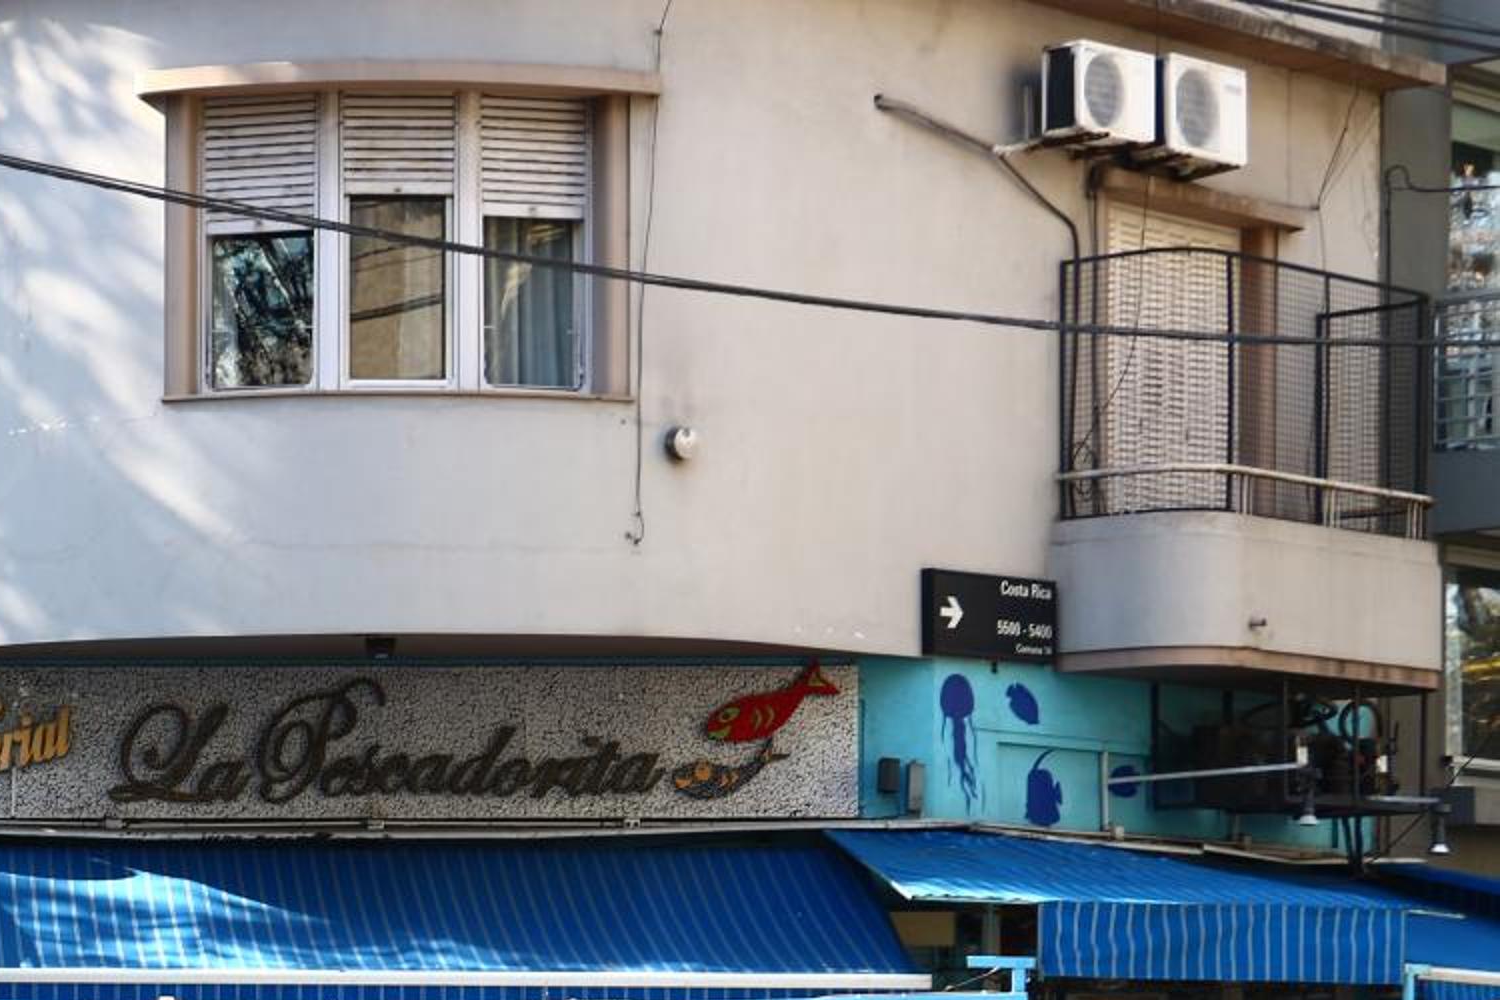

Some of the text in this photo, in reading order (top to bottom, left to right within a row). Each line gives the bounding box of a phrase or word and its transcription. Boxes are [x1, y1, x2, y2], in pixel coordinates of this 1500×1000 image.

[1000, 580, 1053, 600] Costa Rica
[106, 677, 667, 804] La Pescadorita
